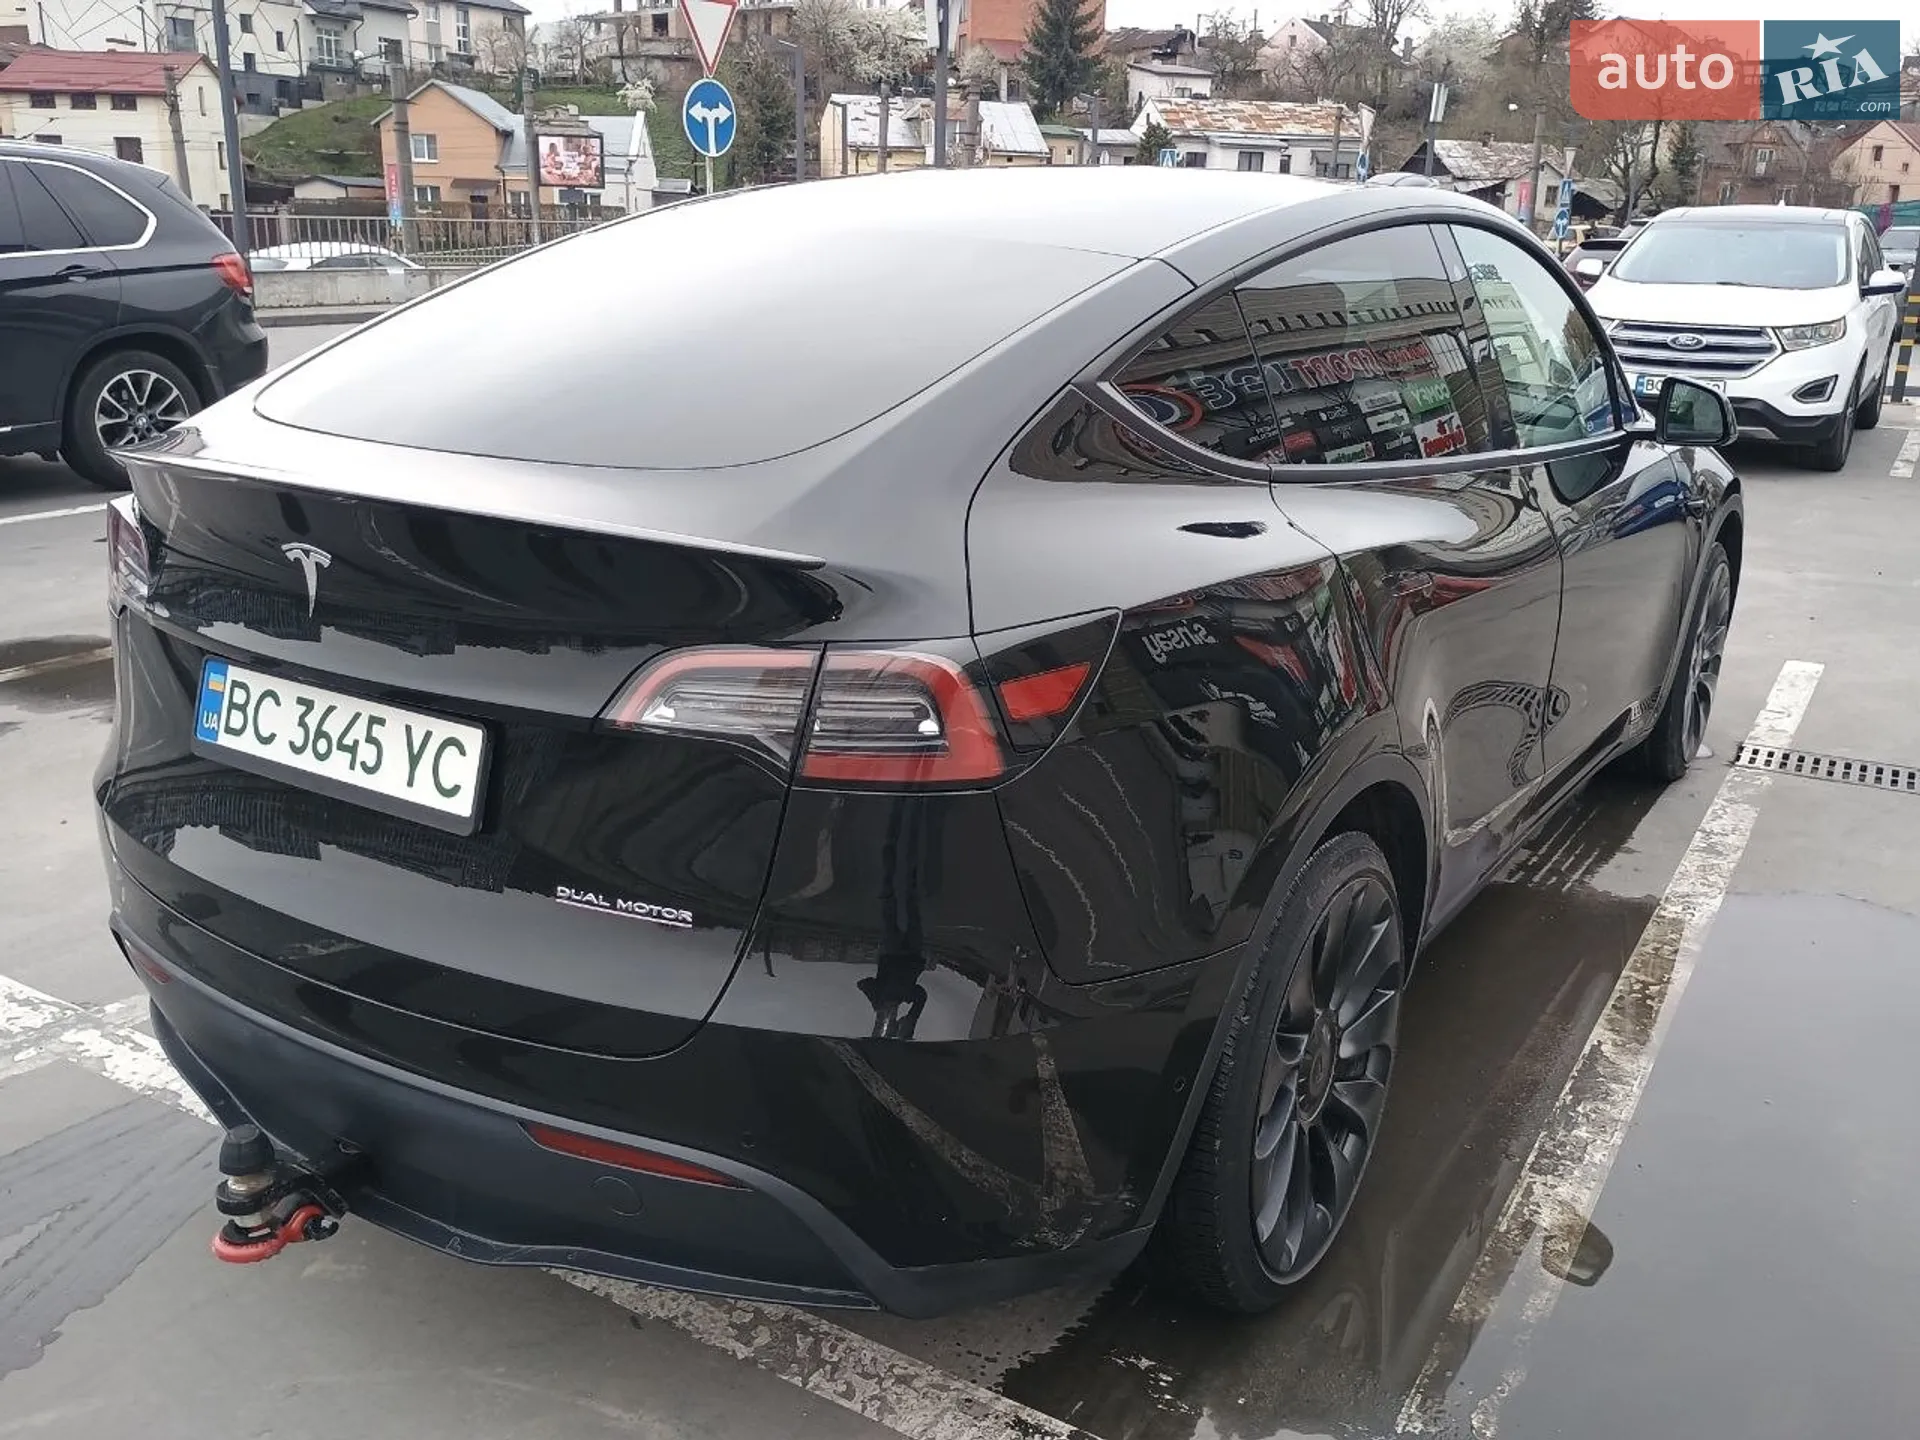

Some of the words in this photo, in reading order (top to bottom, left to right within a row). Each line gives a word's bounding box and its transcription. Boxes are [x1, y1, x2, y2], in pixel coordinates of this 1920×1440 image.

[202, 710, 219, 730] UA
[224, 679, 282, 746] BC
[288, 696, 387, 775] 3645
[404, 724, 467, 798] YC
[556, 886, 610, 906] DUAL
[616, 898, 693, 922] MOTOR
